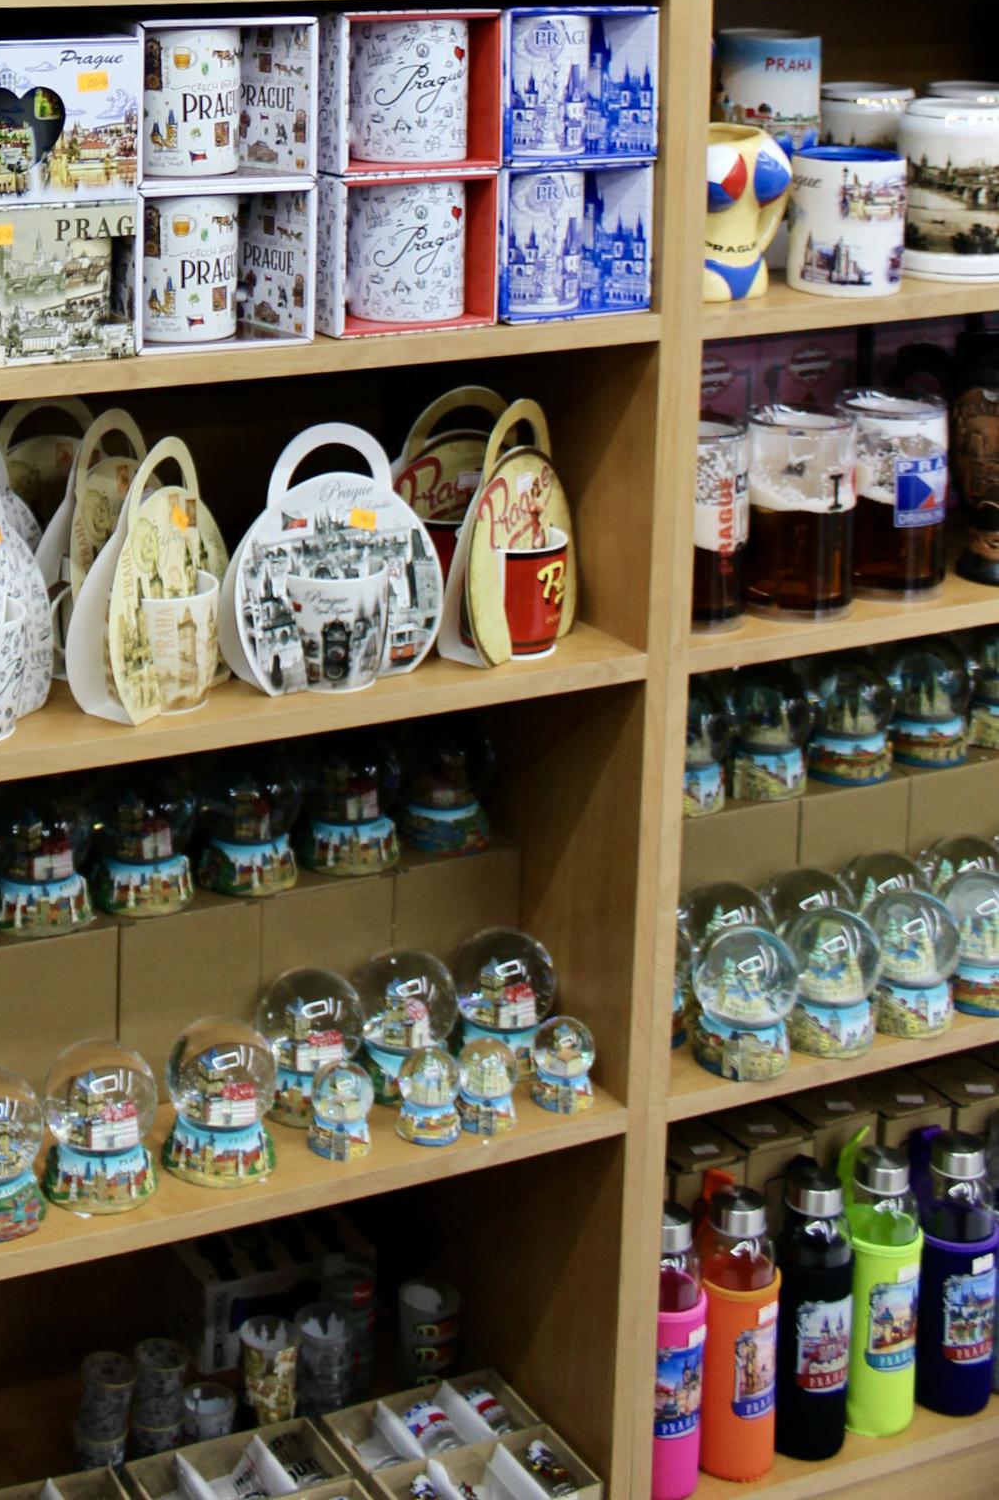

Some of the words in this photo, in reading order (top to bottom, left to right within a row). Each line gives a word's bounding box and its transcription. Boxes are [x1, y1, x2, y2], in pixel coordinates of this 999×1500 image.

[60, 49, 124, 70] Prague
[765, 56, 813, 73] PRAHA
[240, 82, 295, 112] PRAGUE
[54, 215, 135, 242] PRAG
[243, 241, 295, 277] PRAGUE
[318, 480, 374, 504] Prague
[828, 473, 844, 511] I
[304, 588, 350, 609] Prague
[155, 606, 175, 658] PRAHA
